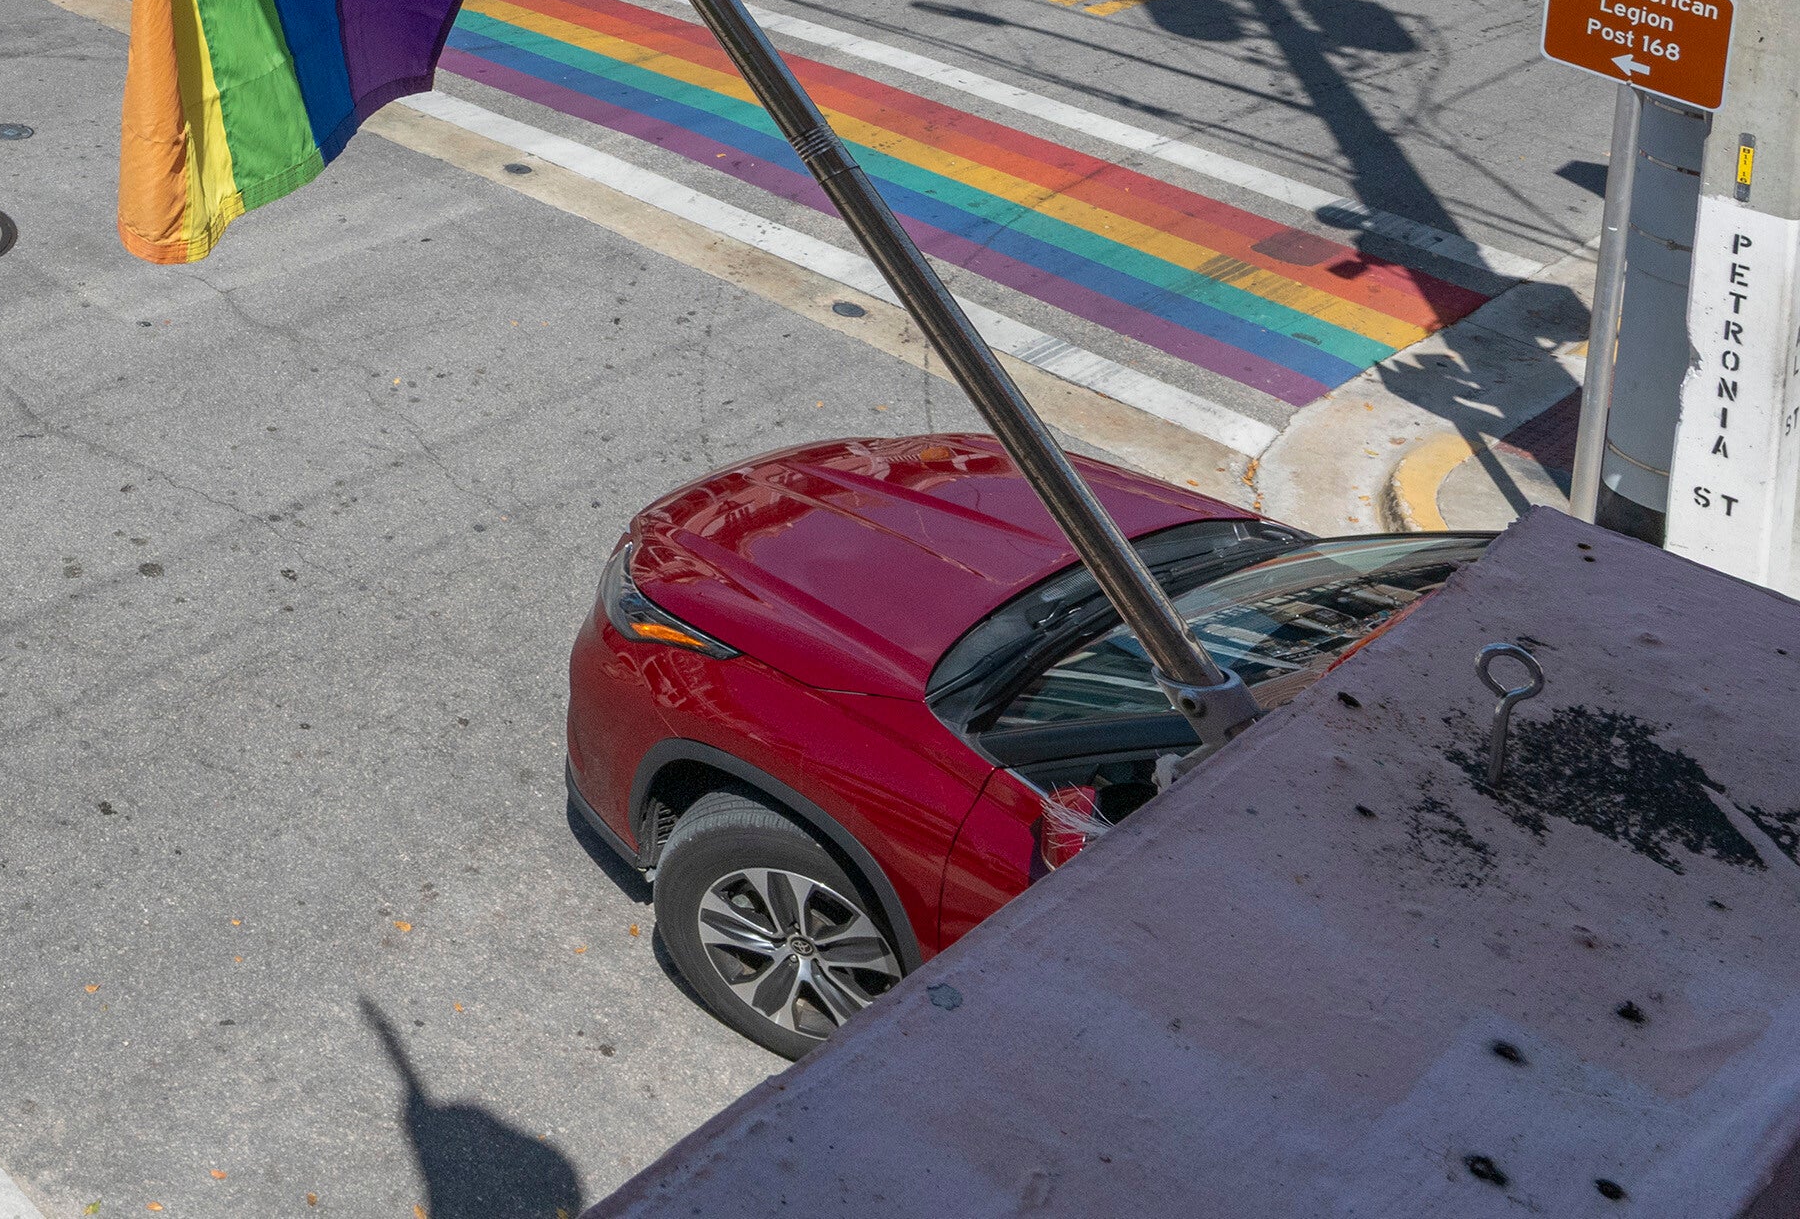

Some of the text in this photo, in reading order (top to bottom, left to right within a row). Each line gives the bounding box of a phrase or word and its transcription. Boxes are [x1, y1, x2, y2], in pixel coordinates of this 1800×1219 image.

[1586, 18, 1680, 61] Post 168
[1711, 233, 1752, 459] PETRONIA
[1693, 485, 1739, 517] ST
